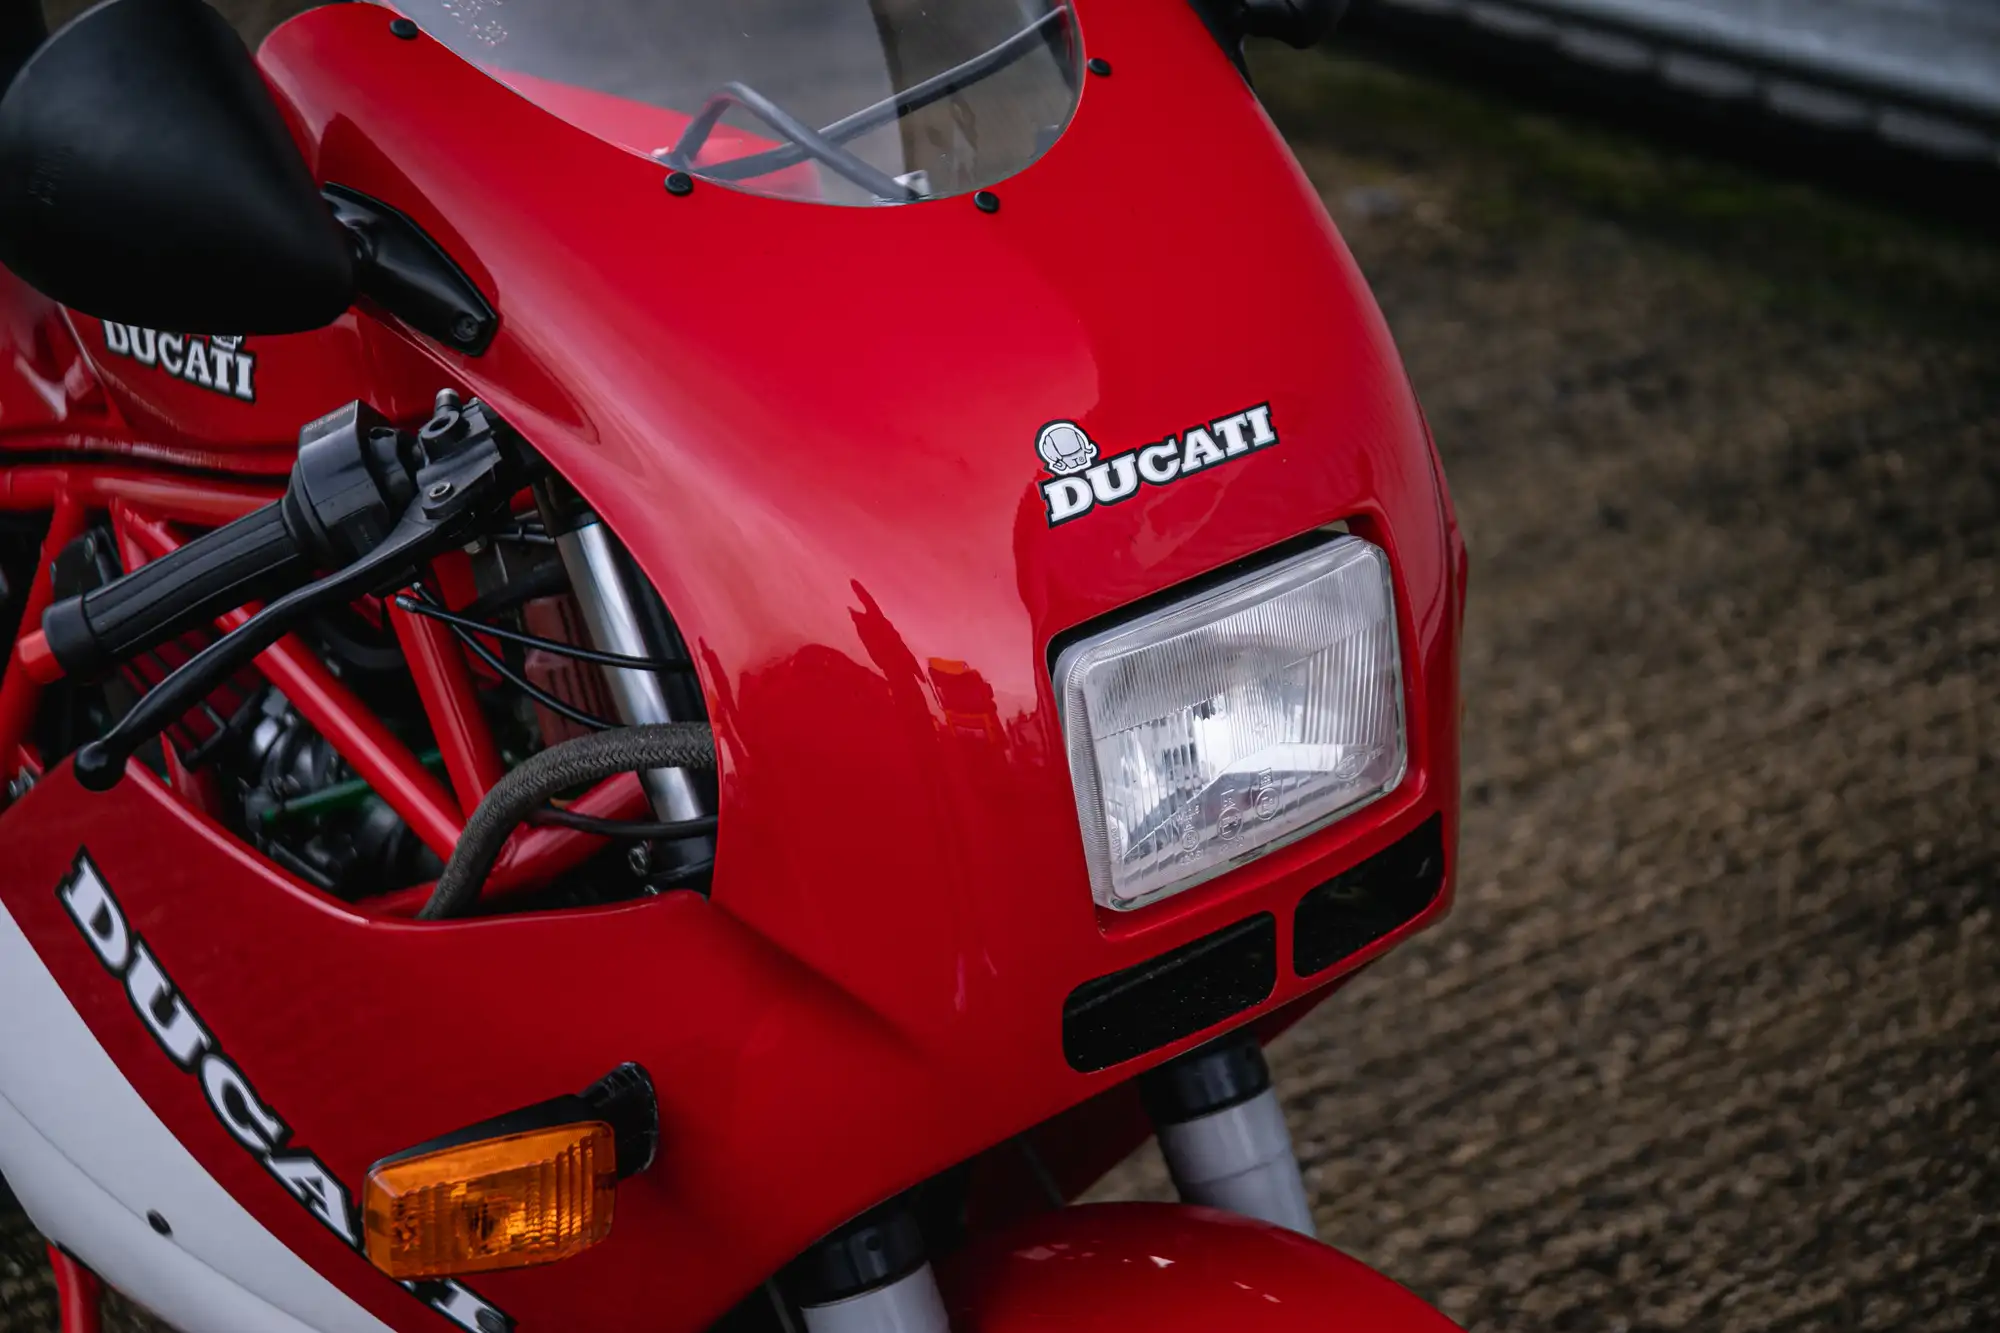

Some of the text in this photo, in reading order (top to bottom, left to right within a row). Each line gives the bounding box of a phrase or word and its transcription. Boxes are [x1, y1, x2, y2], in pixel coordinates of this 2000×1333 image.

[103, 319, 254, 400] DUCATI
[1043, 405, 1277, 523] DUCATI
[62, 857, 506, 1333] DUCAI
